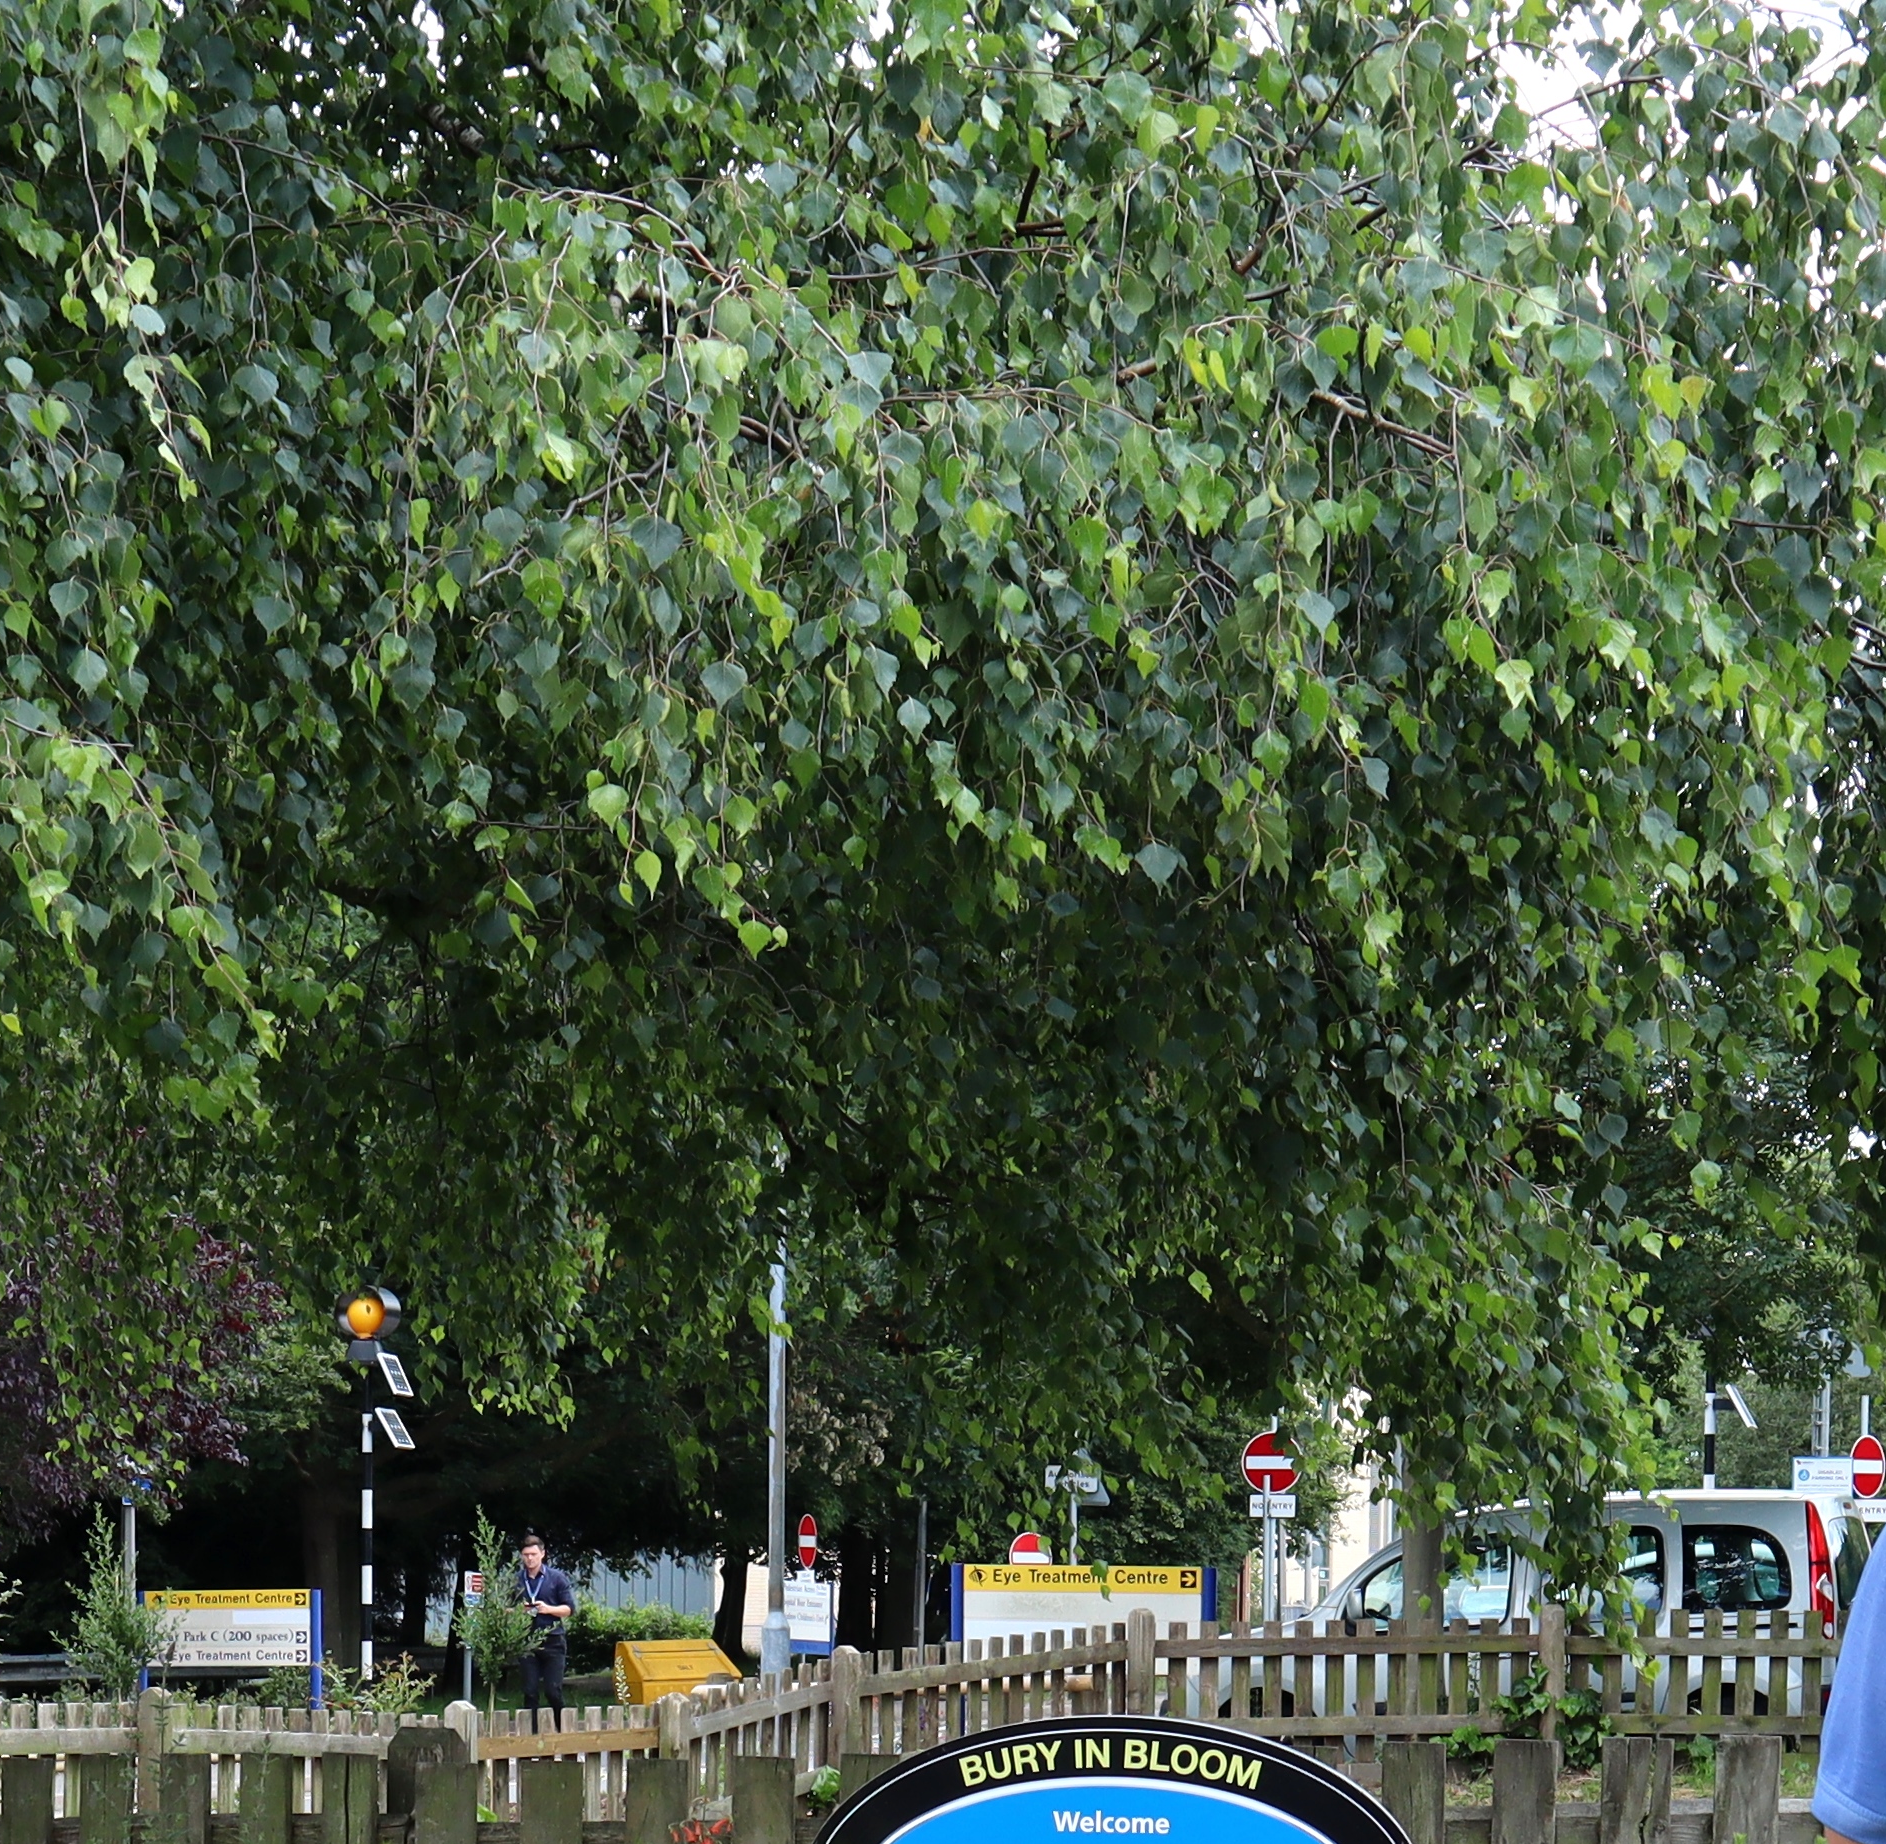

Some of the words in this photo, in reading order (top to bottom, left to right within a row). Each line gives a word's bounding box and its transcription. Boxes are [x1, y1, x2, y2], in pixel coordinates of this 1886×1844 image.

[1269, 1502, 1294, 1510] NTRY
[993, 1569, 1021, 1586] Eye
[1115, 1570, 1168, 1584] Centre
[171, 1594, 190, 1606] Eye
[195, 1593, 250, 1604] Treatment
[255, 1593, 292, 1603] Centre
[184, 1631, 206, 1642] Park
[210, 1631, 219, 1641] C
[222, 1630, 252, 1643] (200
[256, 1628, 294, 1644] spaces)
[172, 1651, 191, 1661] Eye
[197, 1650, 251, 1661] Treatment
[256, 1650, 293, 1660] Centre
[958, 1740, 1062, 1787] BURY
[1074, 1738, 1110, 1769] IN
[1124, 1739, 1262, 1790] BLOOM
[1053, 1810, 1170, 1834] Welcome
